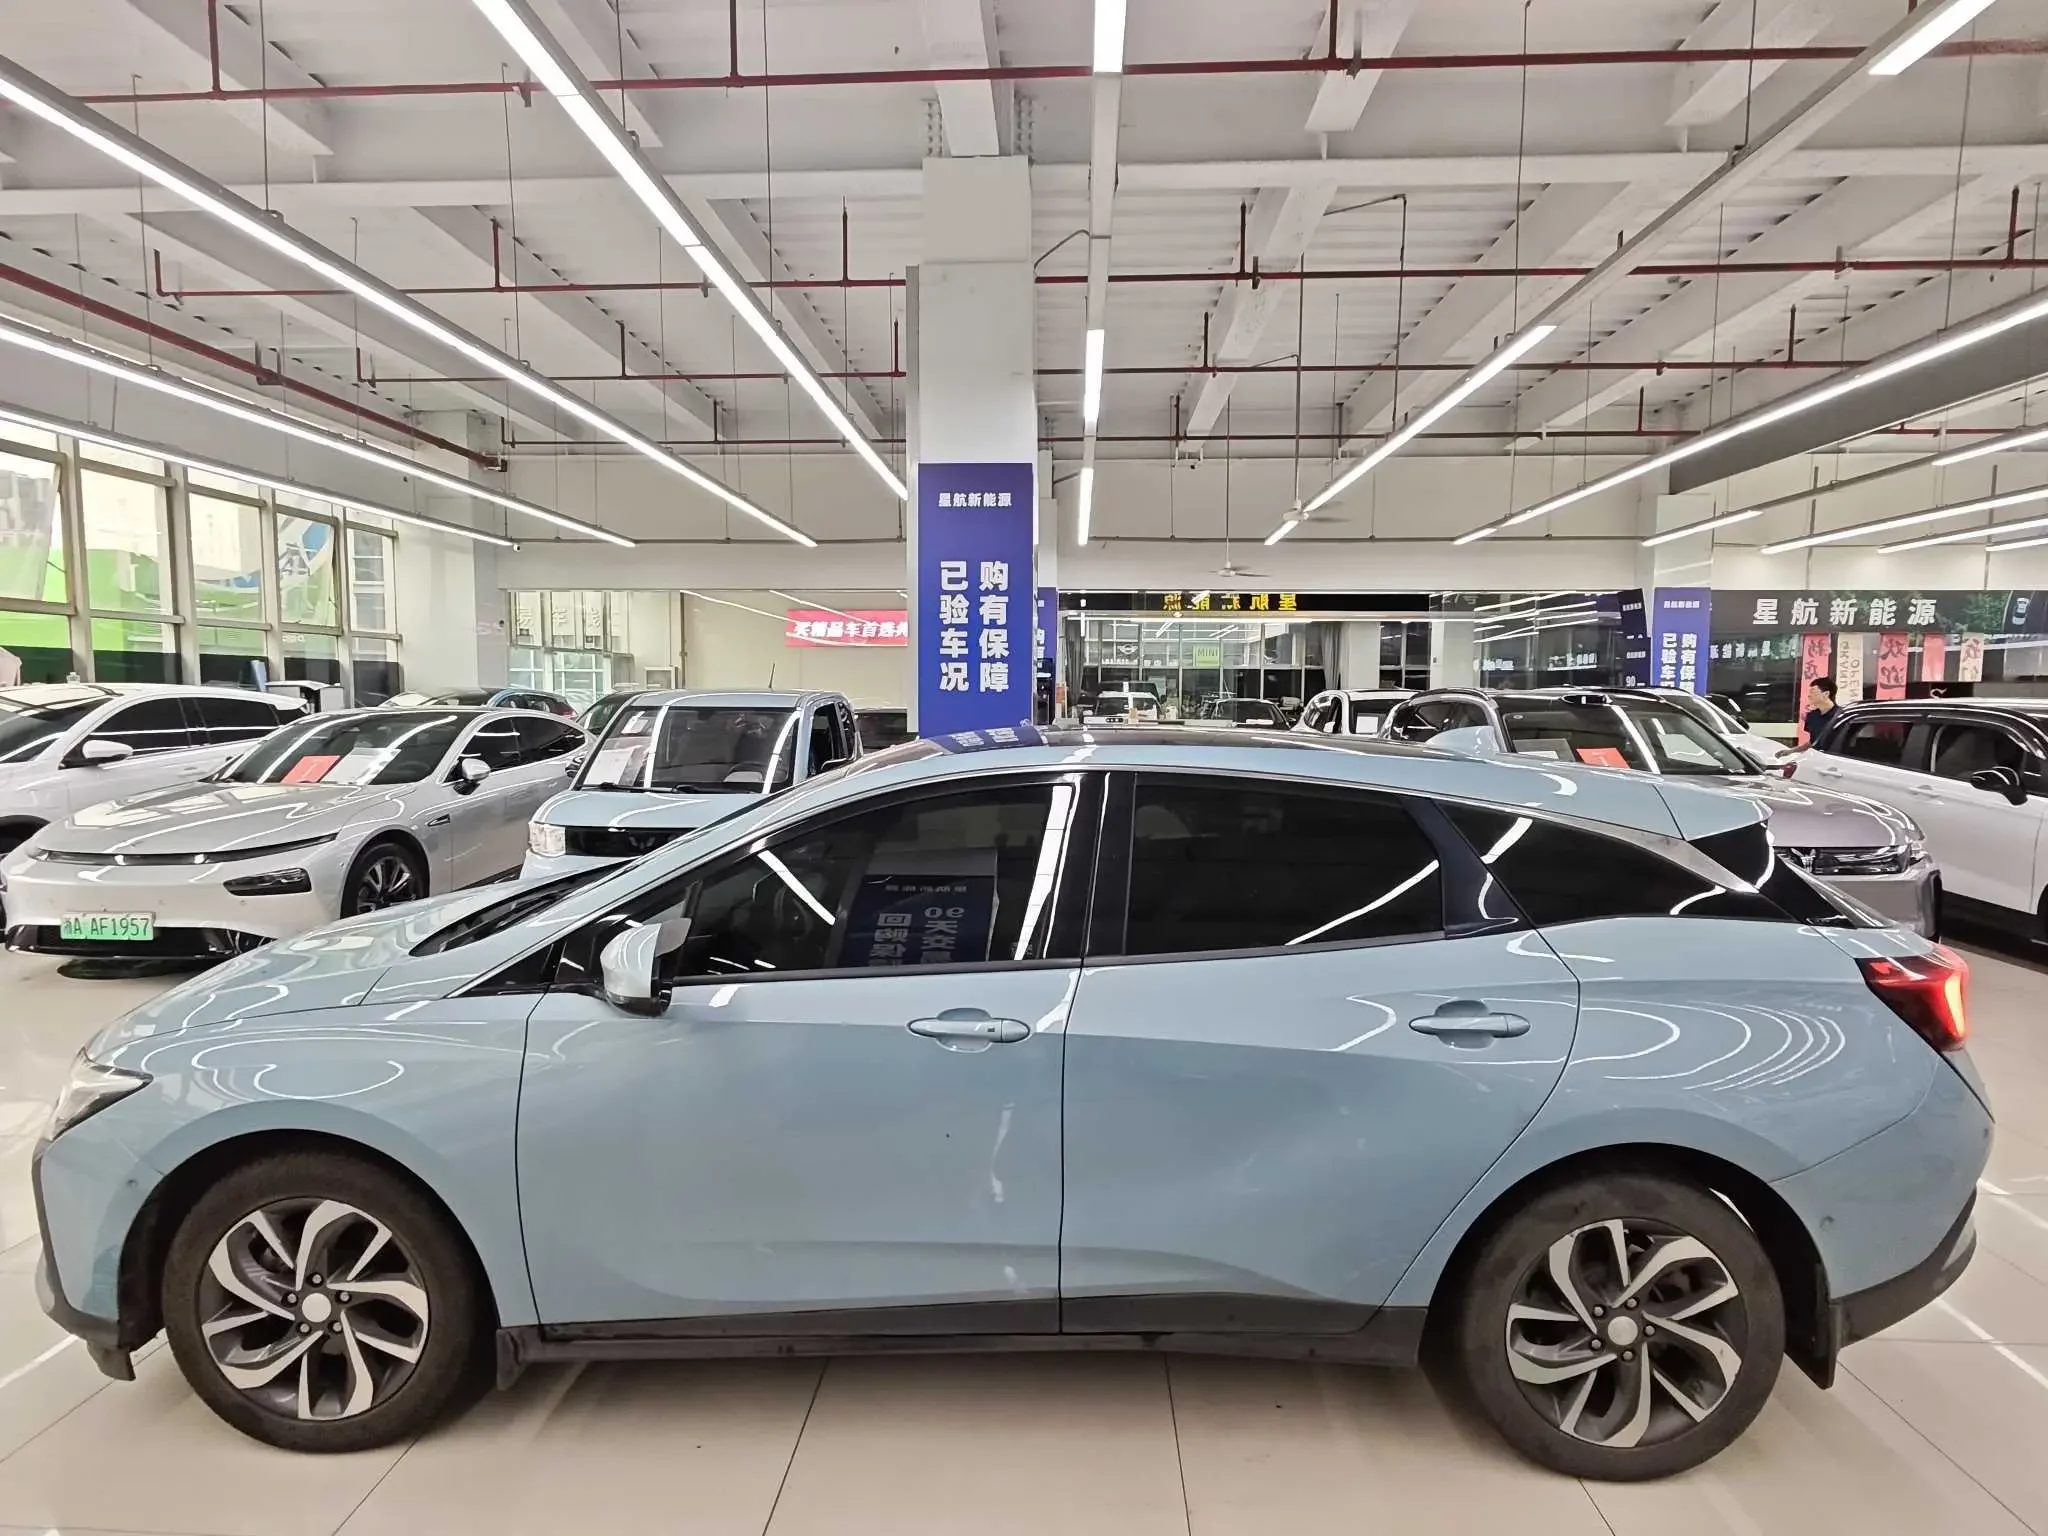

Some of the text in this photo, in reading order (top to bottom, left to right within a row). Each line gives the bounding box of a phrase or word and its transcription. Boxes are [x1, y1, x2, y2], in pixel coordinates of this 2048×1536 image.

[938, 492, 1012, 507] 星航新能源
[1753, 598, 1937, 626] 星航新能源
[939, 561, 969, 692] 已验车况
[979, 560, 1009, 693] 购有保障
[90, 918, 149, 936] AF1957
